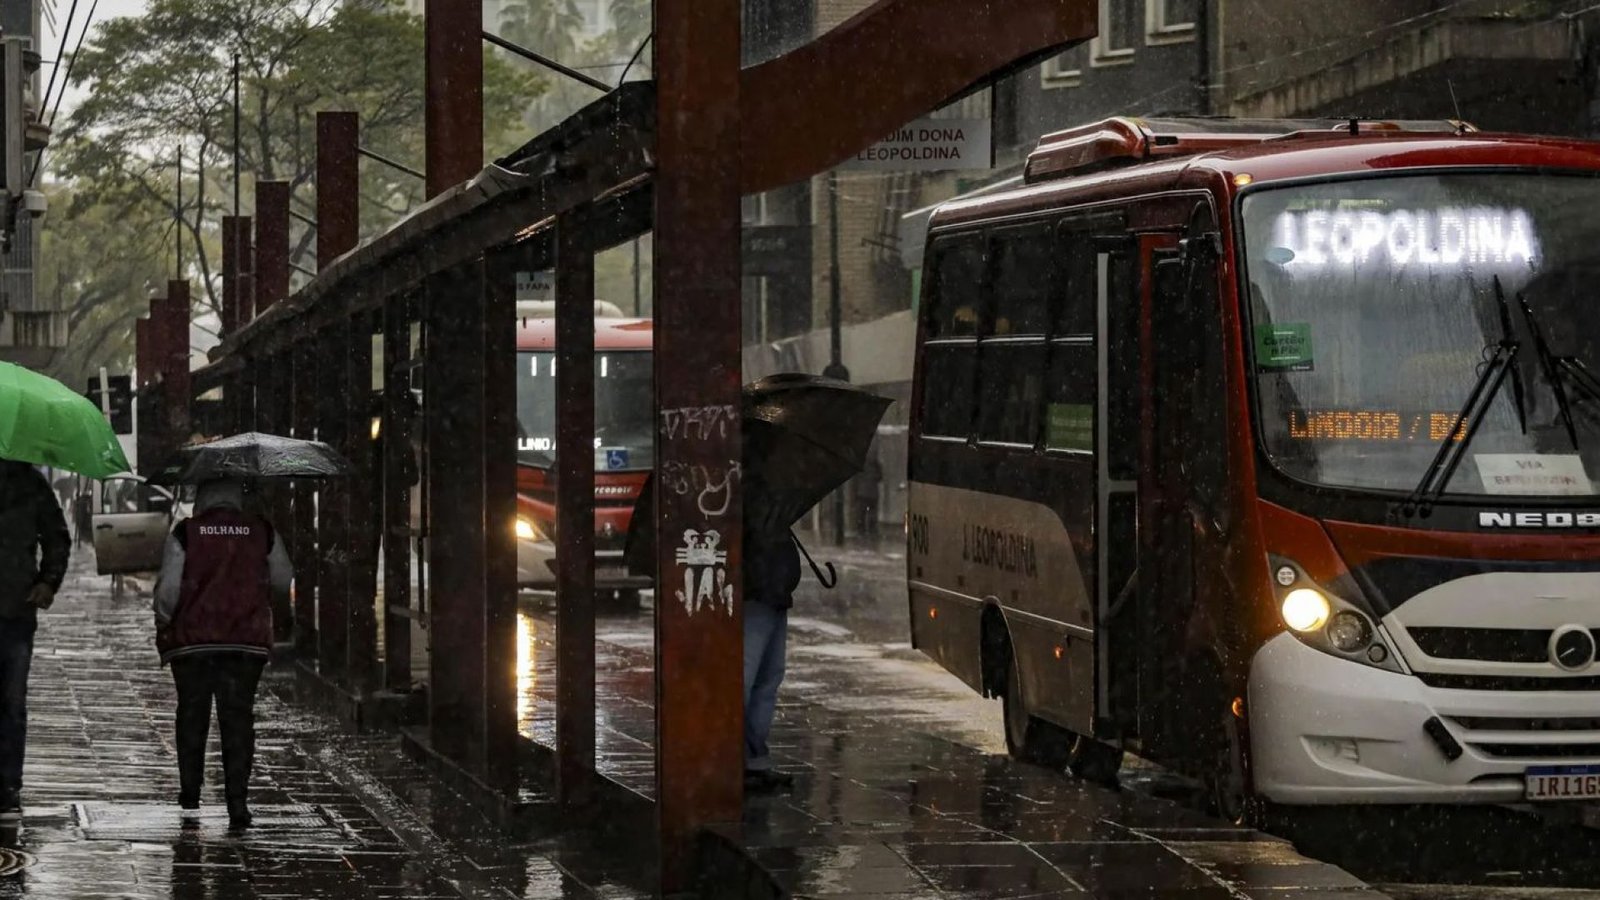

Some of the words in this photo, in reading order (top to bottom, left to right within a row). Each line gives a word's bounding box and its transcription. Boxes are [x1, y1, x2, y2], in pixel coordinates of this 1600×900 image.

[881, 129, 913, 143] DIM
[919, 128, 965, 142] DONA
[857, 146, 961, 161] LEOPOLDINA
[1280, 211, 1536, 264] LEOPOLDINA
[199, 525, 251, 536] ROLHANO
[972, 524, 1039, 580] LEOPOLDINA
[1535, 774, 1600, 797] IRI1G
